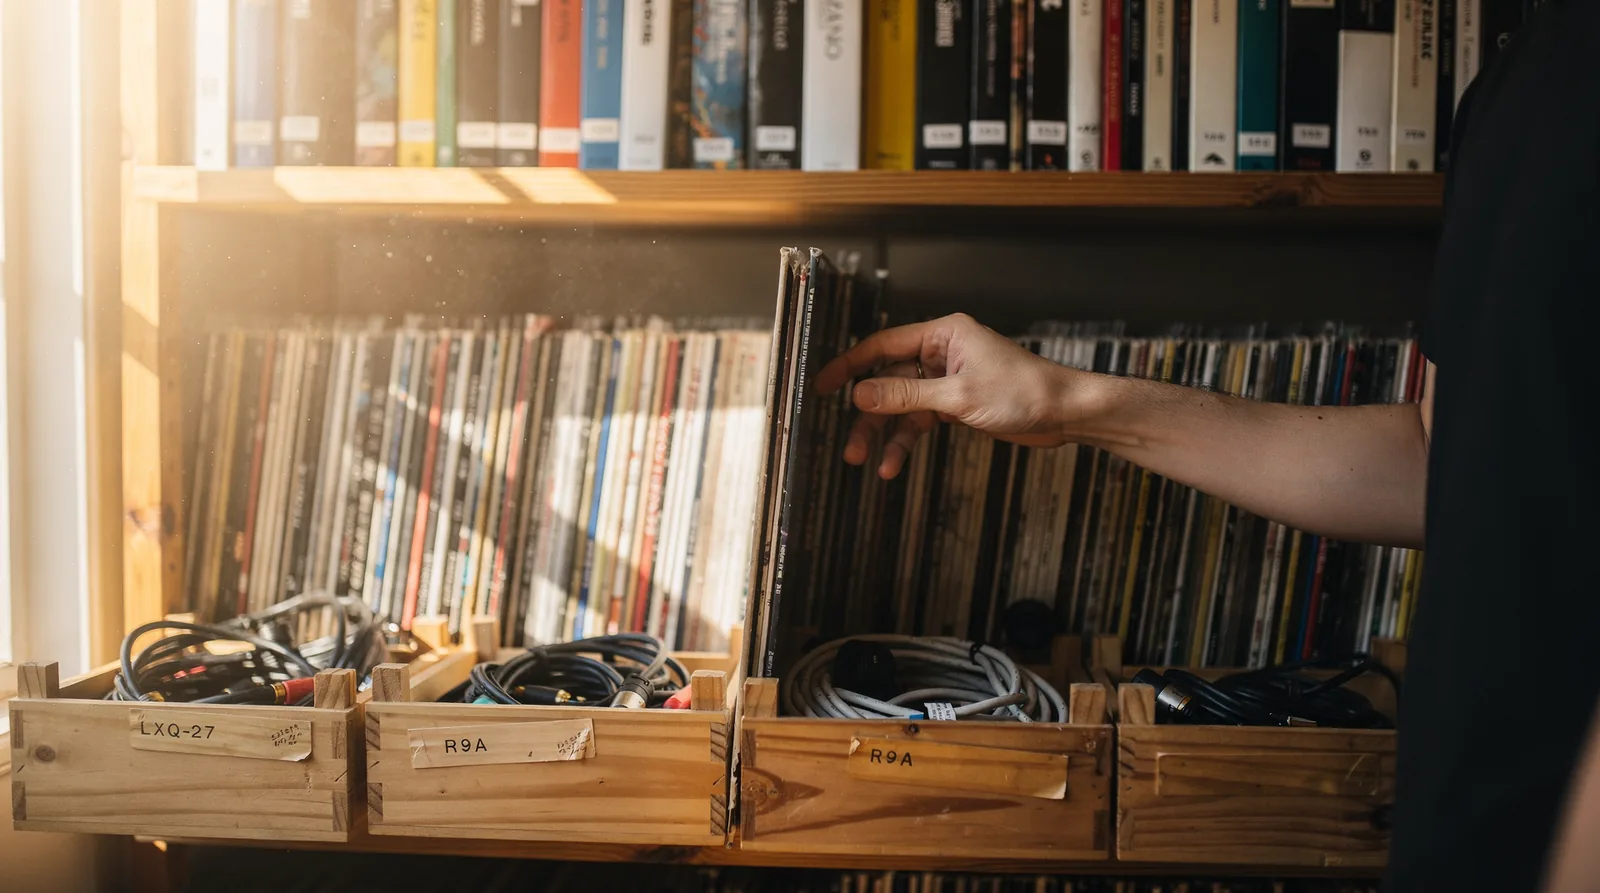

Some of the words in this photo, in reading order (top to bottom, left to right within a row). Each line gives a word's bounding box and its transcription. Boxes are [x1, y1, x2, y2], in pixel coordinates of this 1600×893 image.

[140, 721, 215, 740] LXQ-27
[444, 738, 488, 754] R9A
[870, 748, 913, 767] R9A
